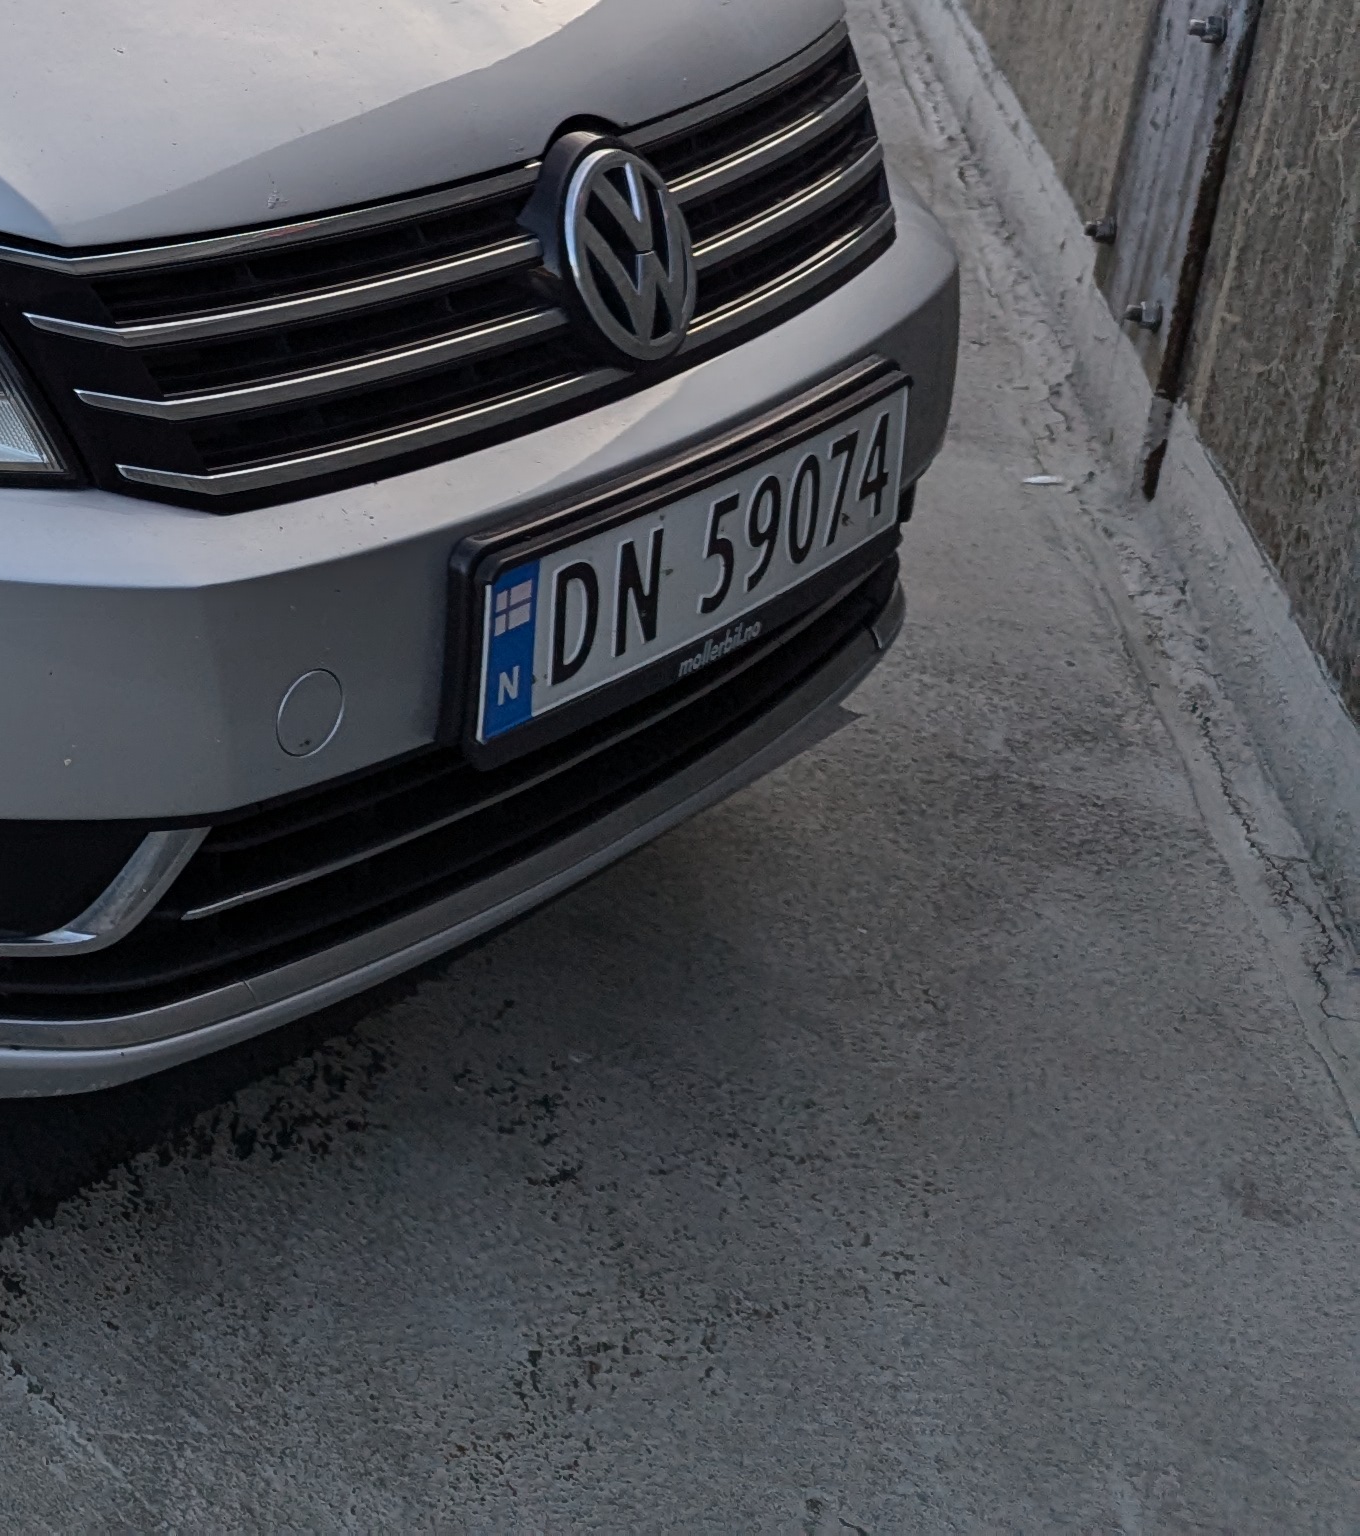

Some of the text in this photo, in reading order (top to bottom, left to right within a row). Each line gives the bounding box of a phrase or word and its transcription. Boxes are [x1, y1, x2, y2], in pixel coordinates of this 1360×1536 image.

[548, 410, 891, 688] DN 59074
[497, 666, 520, 706] N
